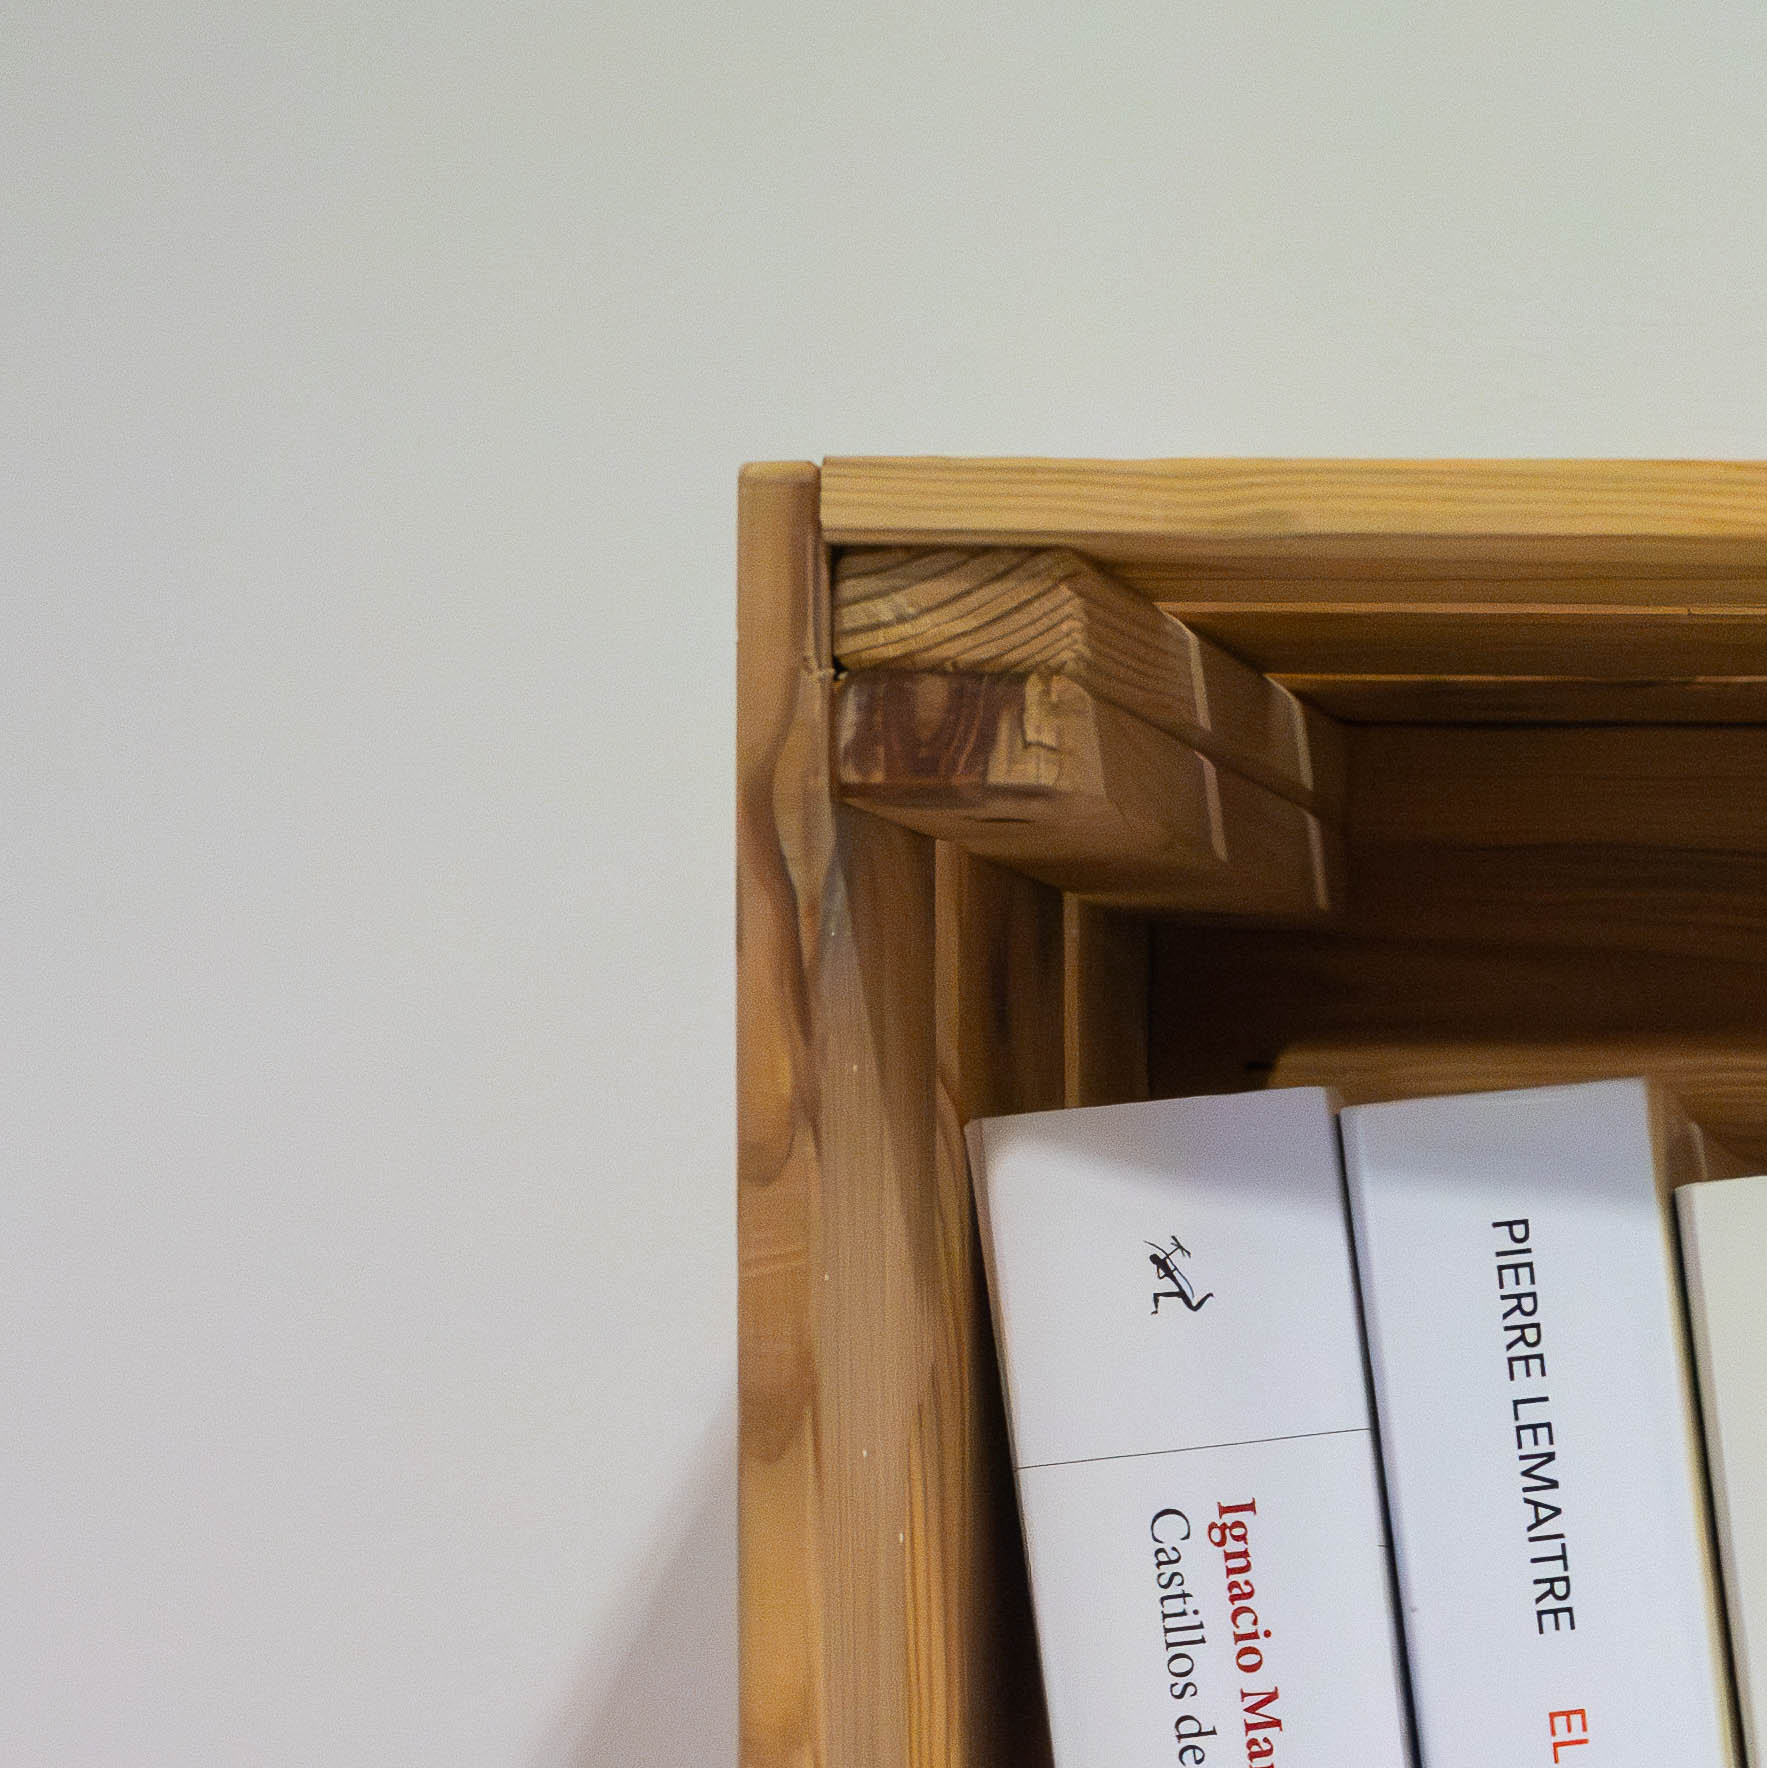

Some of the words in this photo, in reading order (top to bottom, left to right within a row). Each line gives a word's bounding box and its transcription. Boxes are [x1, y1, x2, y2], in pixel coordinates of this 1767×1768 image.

[1491, 1218, 1547, 1382] PIERRE
[1207, 1497, 1273, 1674] Ignacio
[1512, 1396, 1576, 1635] LEMAITRE
[1150, 1508, 1207, 1700] Castillos
[1174, 1714, 1218, 1767] de
[1548, 1708, 1590, 1764] EL
